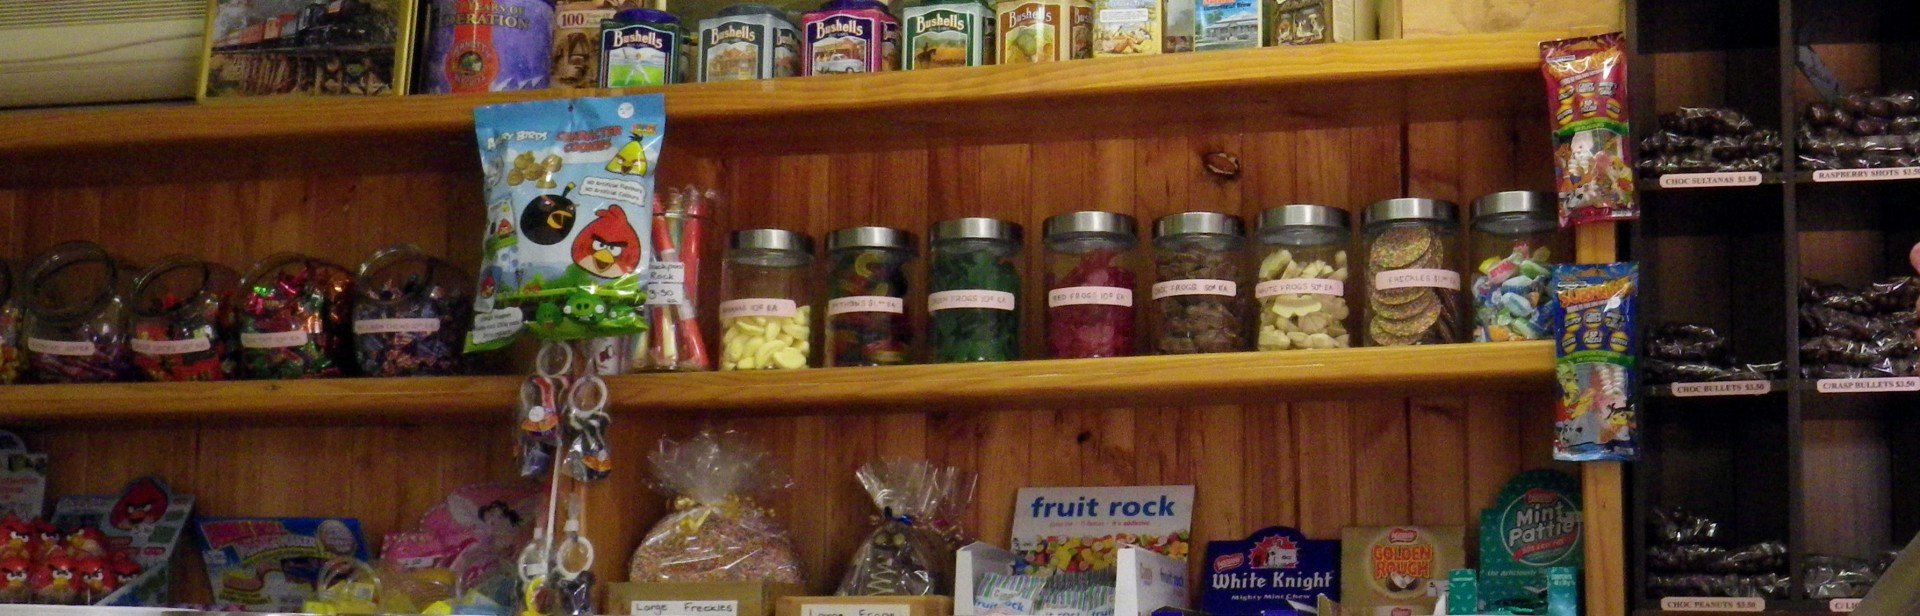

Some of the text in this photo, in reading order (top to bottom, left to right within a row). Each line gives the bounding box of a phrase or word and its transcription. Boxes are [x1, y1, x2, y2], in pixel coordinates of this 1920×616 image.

[562, 13, 584, 26] 100
[916, 13, 964, 34] Bushells
[1009, 7, 1052, 28] Bushells
[711, 25, 755, 45] Bushells
[816, 19, 863, 39] Bushells
[614, 30, 663, 49] Bushells
[1666, 178, 1691, 186] CHOC
[1692, 176, 1734, 185] SULTANAS
[1818, 170, 1869, 180] RASPBERRY
[1871, 169, 1899, 177] SHOTS
[1170, 283, 1197, 292] FROGS
[1677, 385, 1701, 394] CHOC
[1703, 384, 1742, 393] BULLETS
[1823, 382, 1853, 391] C/RASP
[1854, 381, 1894, 390] BULLETS
[1031, 495, 1176, 518] fruit rock
[1516, 501, 1563, 528] Mint
[1508, 515, 1575, 547] Pattie
[1371, 544, 1433, 562] GOLDEN
[1375, 559, 1430, 580] ROUGH
[1212, 571, 1334, 591] White Knight
[636, 601, 733, 615] Large Freckles
[1667, 601, 1692, 609] CHOC
[1694, 601, 1734, 609] PEANUTS
